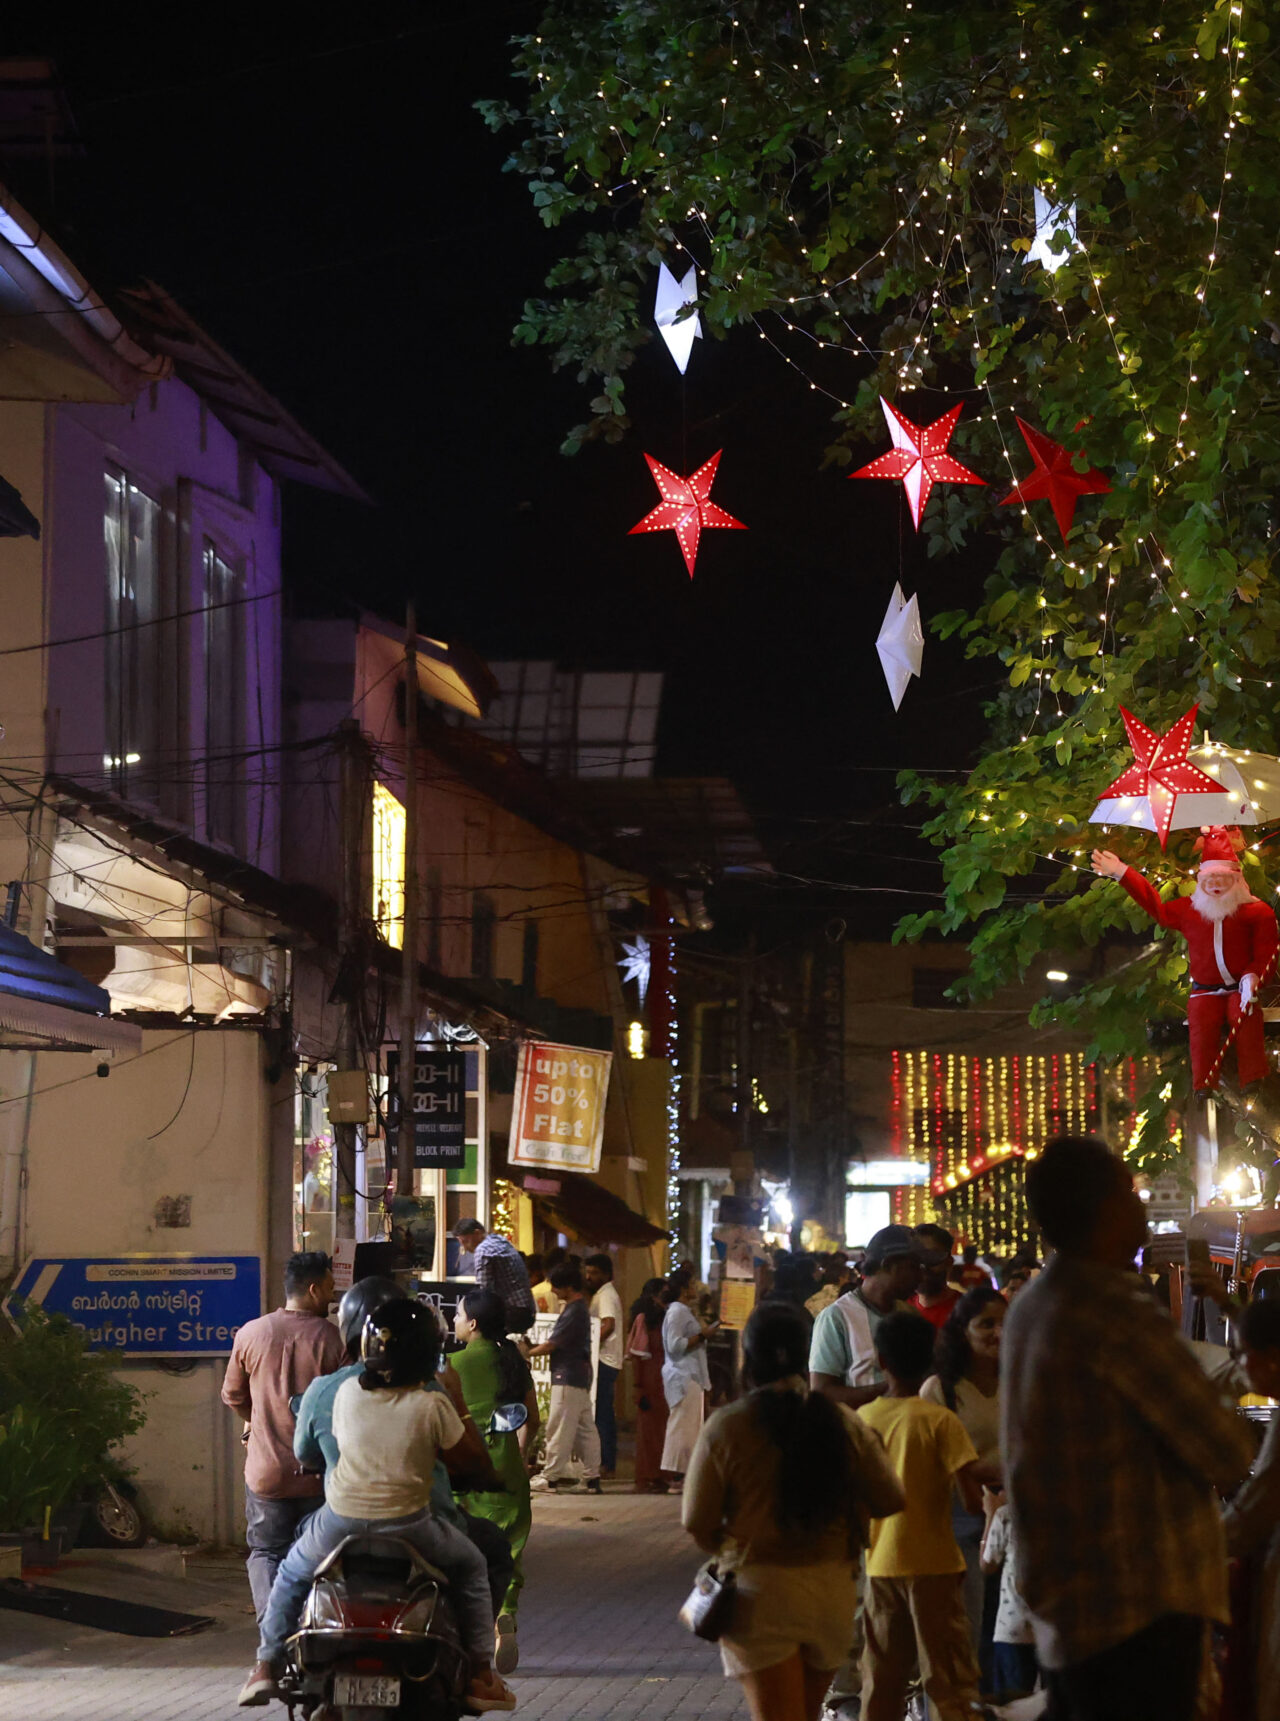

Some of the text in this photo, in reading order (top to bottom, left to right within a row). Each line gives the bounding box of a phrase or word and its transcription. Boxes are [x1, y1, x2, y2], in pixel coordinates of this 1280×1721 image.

[536, 1059, 594, 1080] upto
[533, 1083, 589, 1110] 50%
[533, 1113, 584, 1138] Flat
[416, 1145, 461, 1156] BLOCK PRINT
[108, 1269, 139, 1277] COCHIN
[140, 1269, 167, 1277] SMART
[169, 1268, 201, 1277] MISSION
[178, 1321, 241, 1341] Stree
